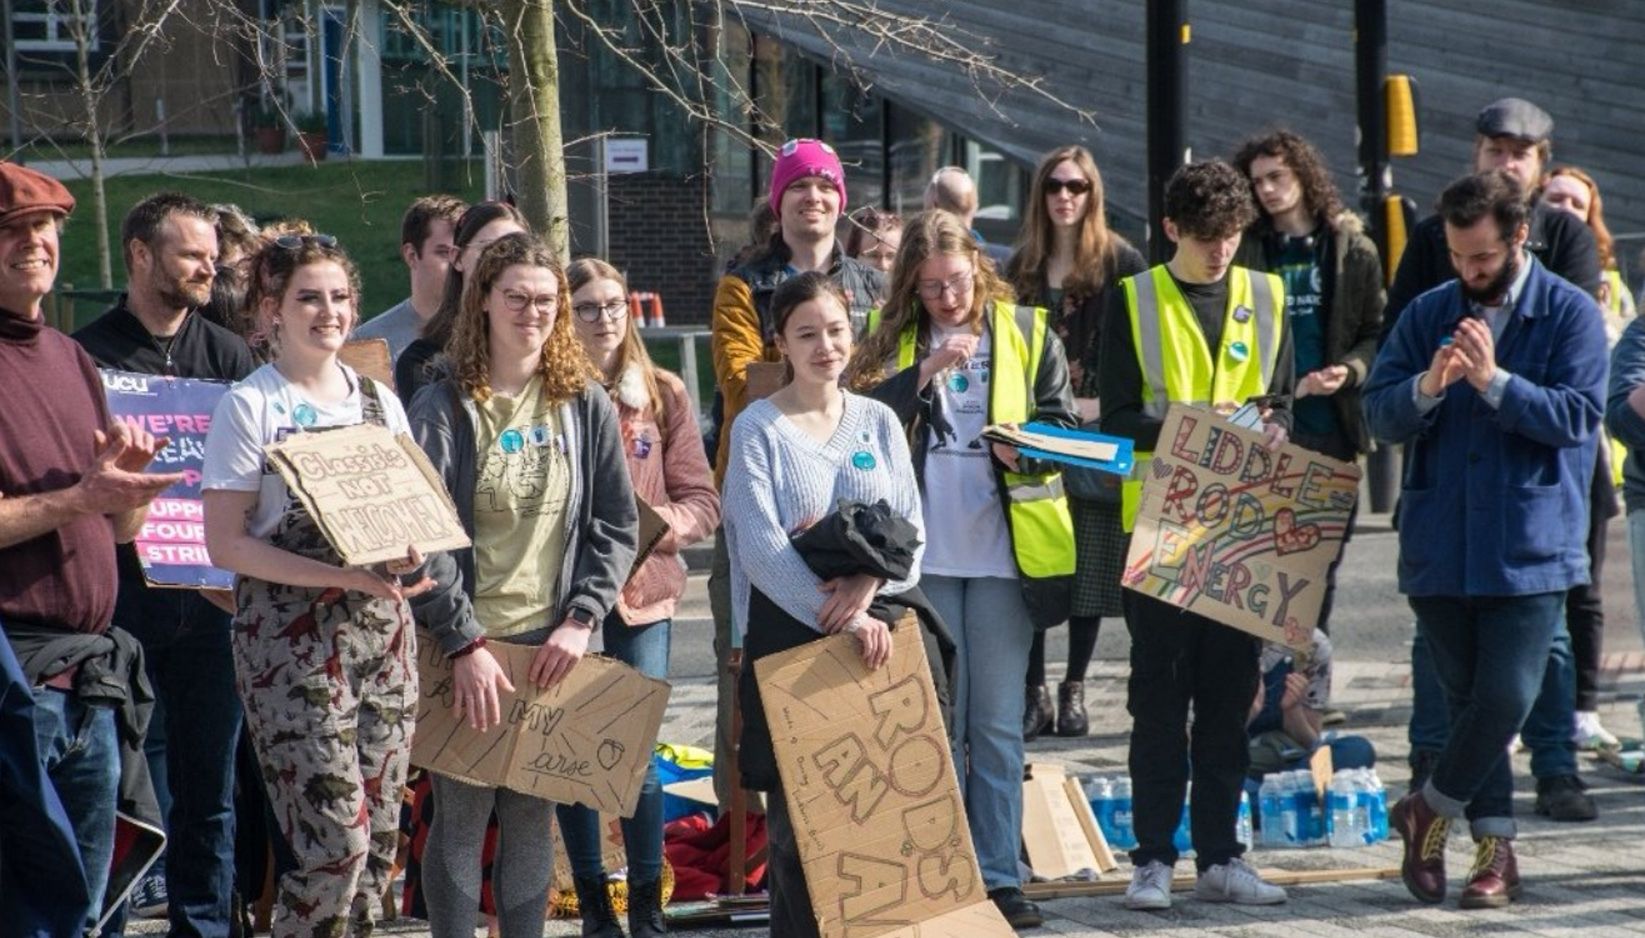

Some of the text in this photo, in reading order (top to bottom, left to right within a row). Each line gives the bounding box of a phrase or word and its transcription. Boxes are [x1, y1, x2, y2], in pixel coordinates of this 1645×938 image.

[338, 472, 392, 501] NOT
[1171, 415, 1334, 511] LIDDLE
[149, 500, 204, 518] UPP
[1162, 464, 1266, 540] ROD
[1149, 517, 1310, 628] ENERGY
[508, 699, 565, 736] MY
[529, 752, 593, 777] arse
[811, 731, 891, 826] AN
